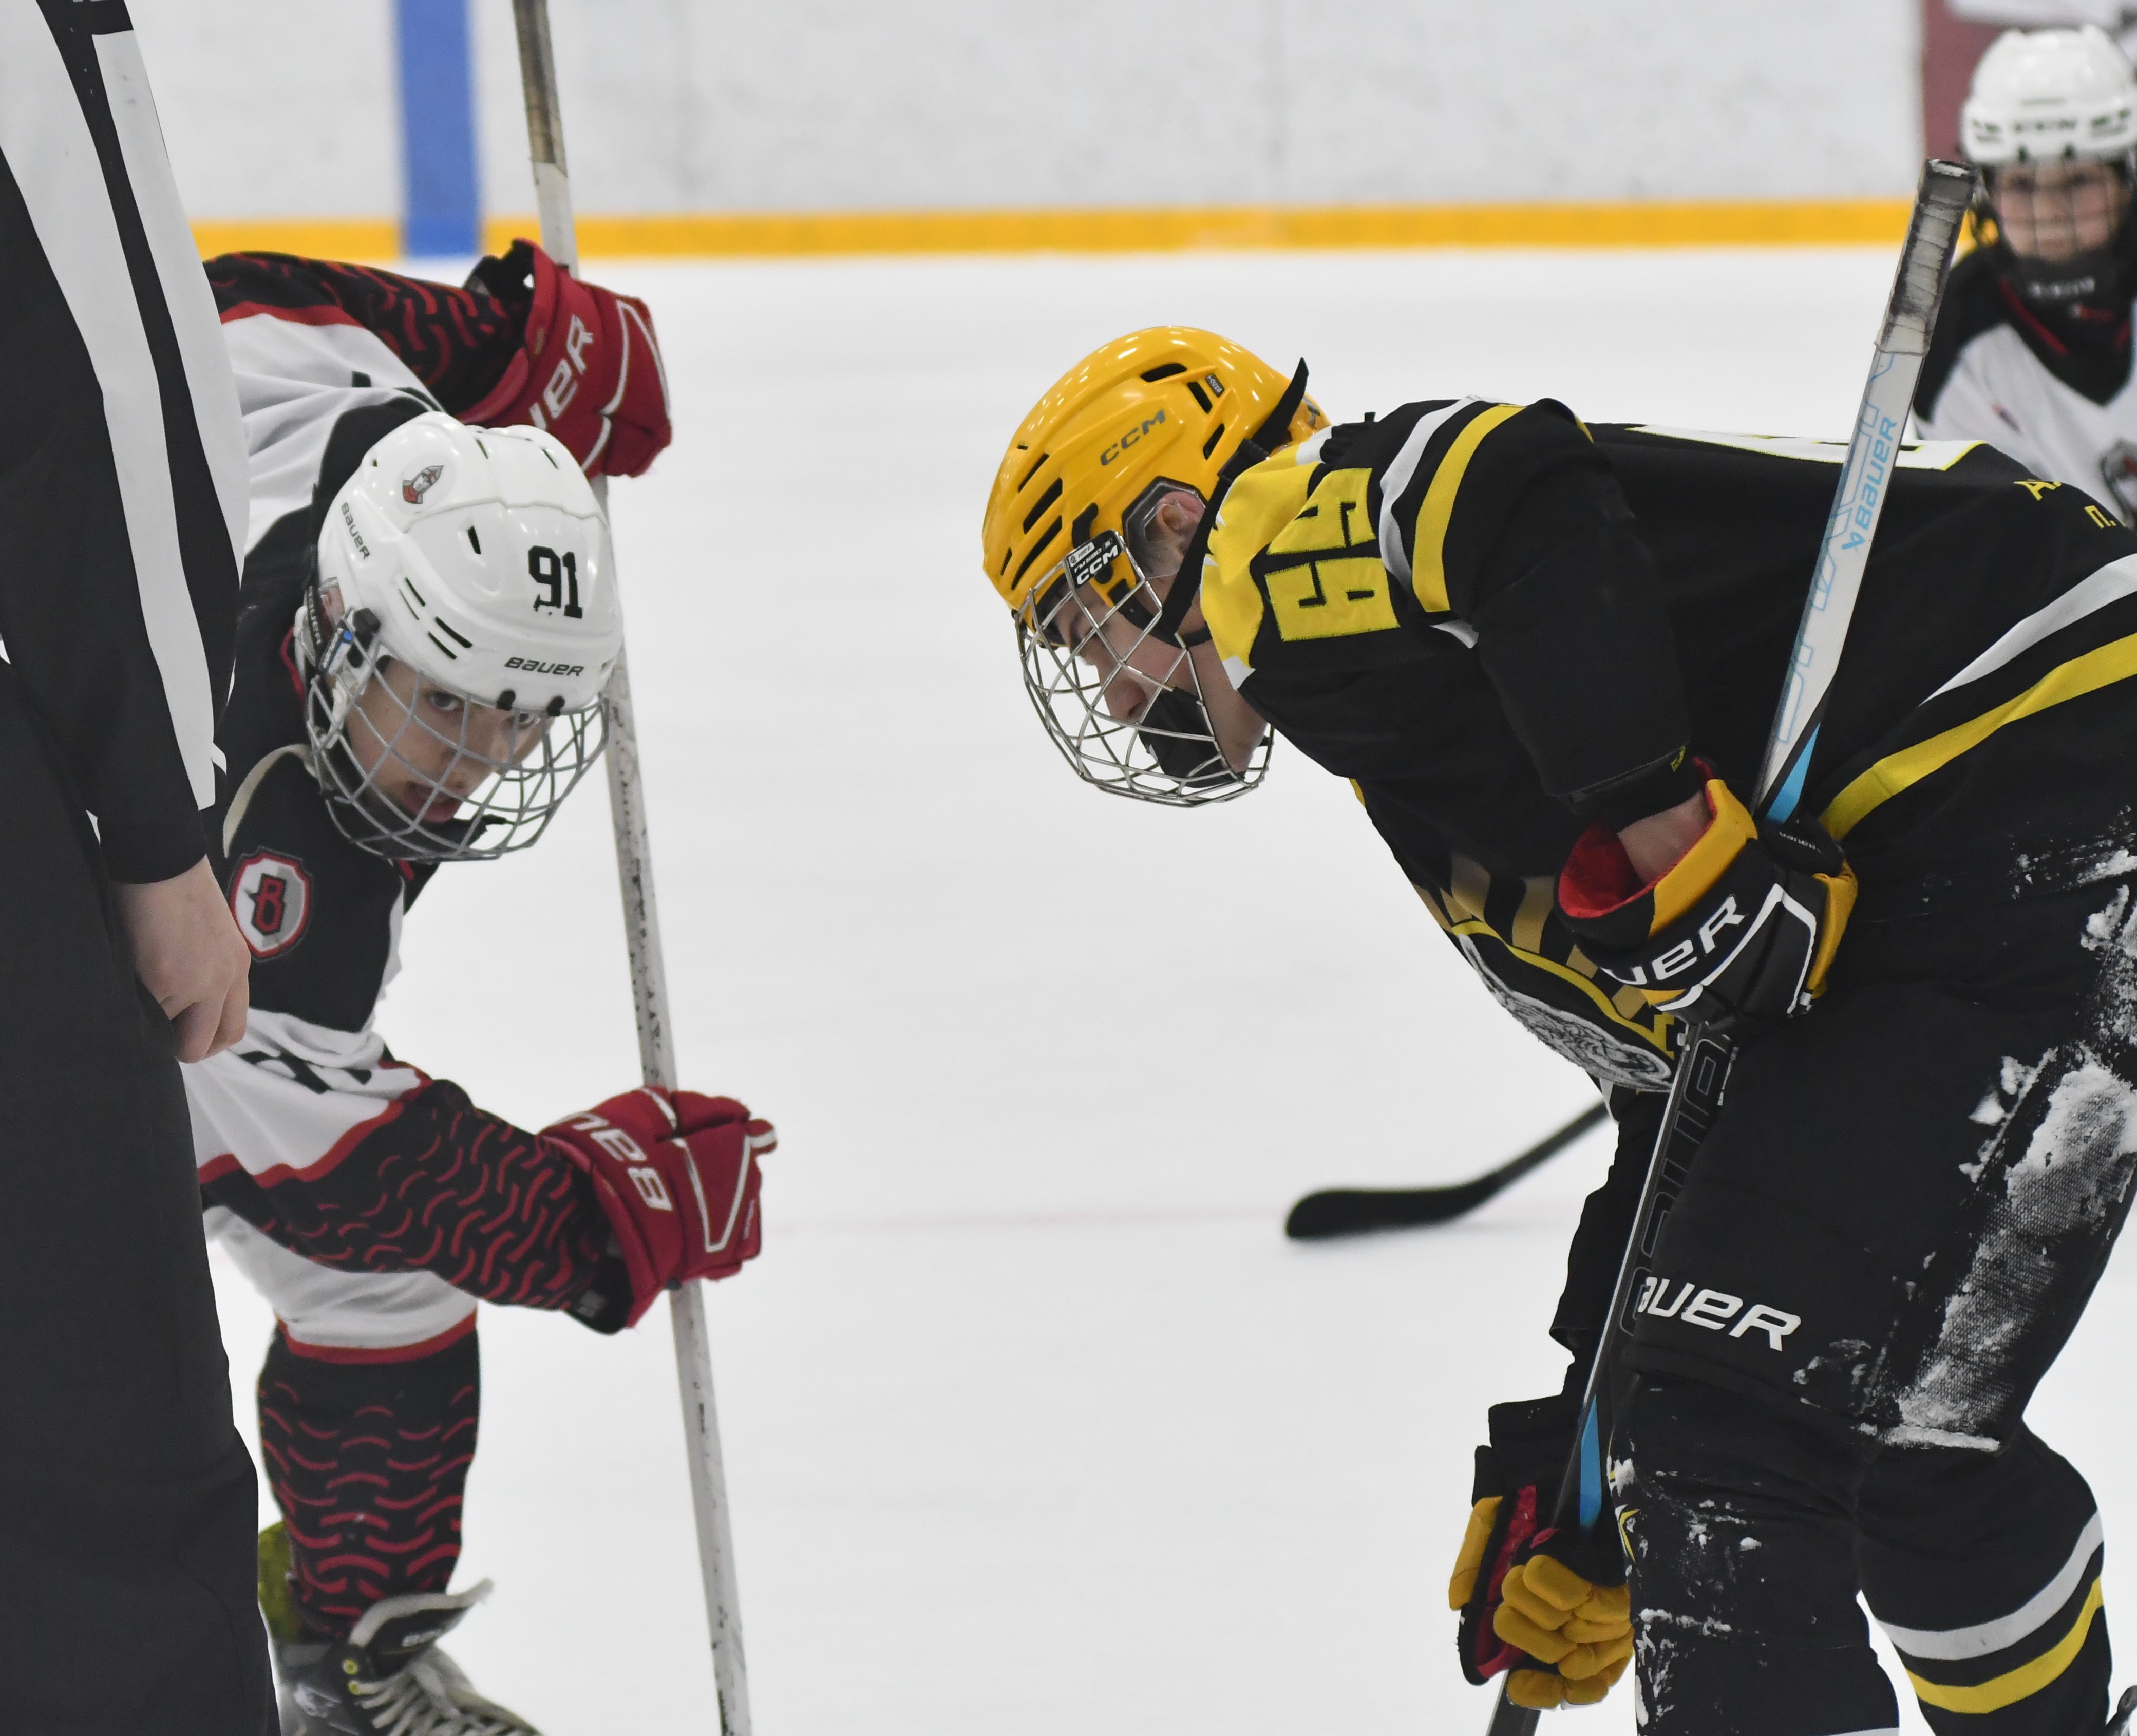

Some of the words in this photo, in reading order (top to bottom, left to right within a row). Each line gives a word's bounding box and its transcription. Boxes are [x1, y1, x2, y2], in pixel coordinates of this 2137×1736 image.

[1100, 409, 1165, 466] CCM
[1855, 417, 1897, 531] BAUER
[341, 502, 370, 560] BAUER
[528, 545, 583, 619] 91
[1076, 544, 1119, 585] CCM
[504, 657, 584, 677] BAUER
